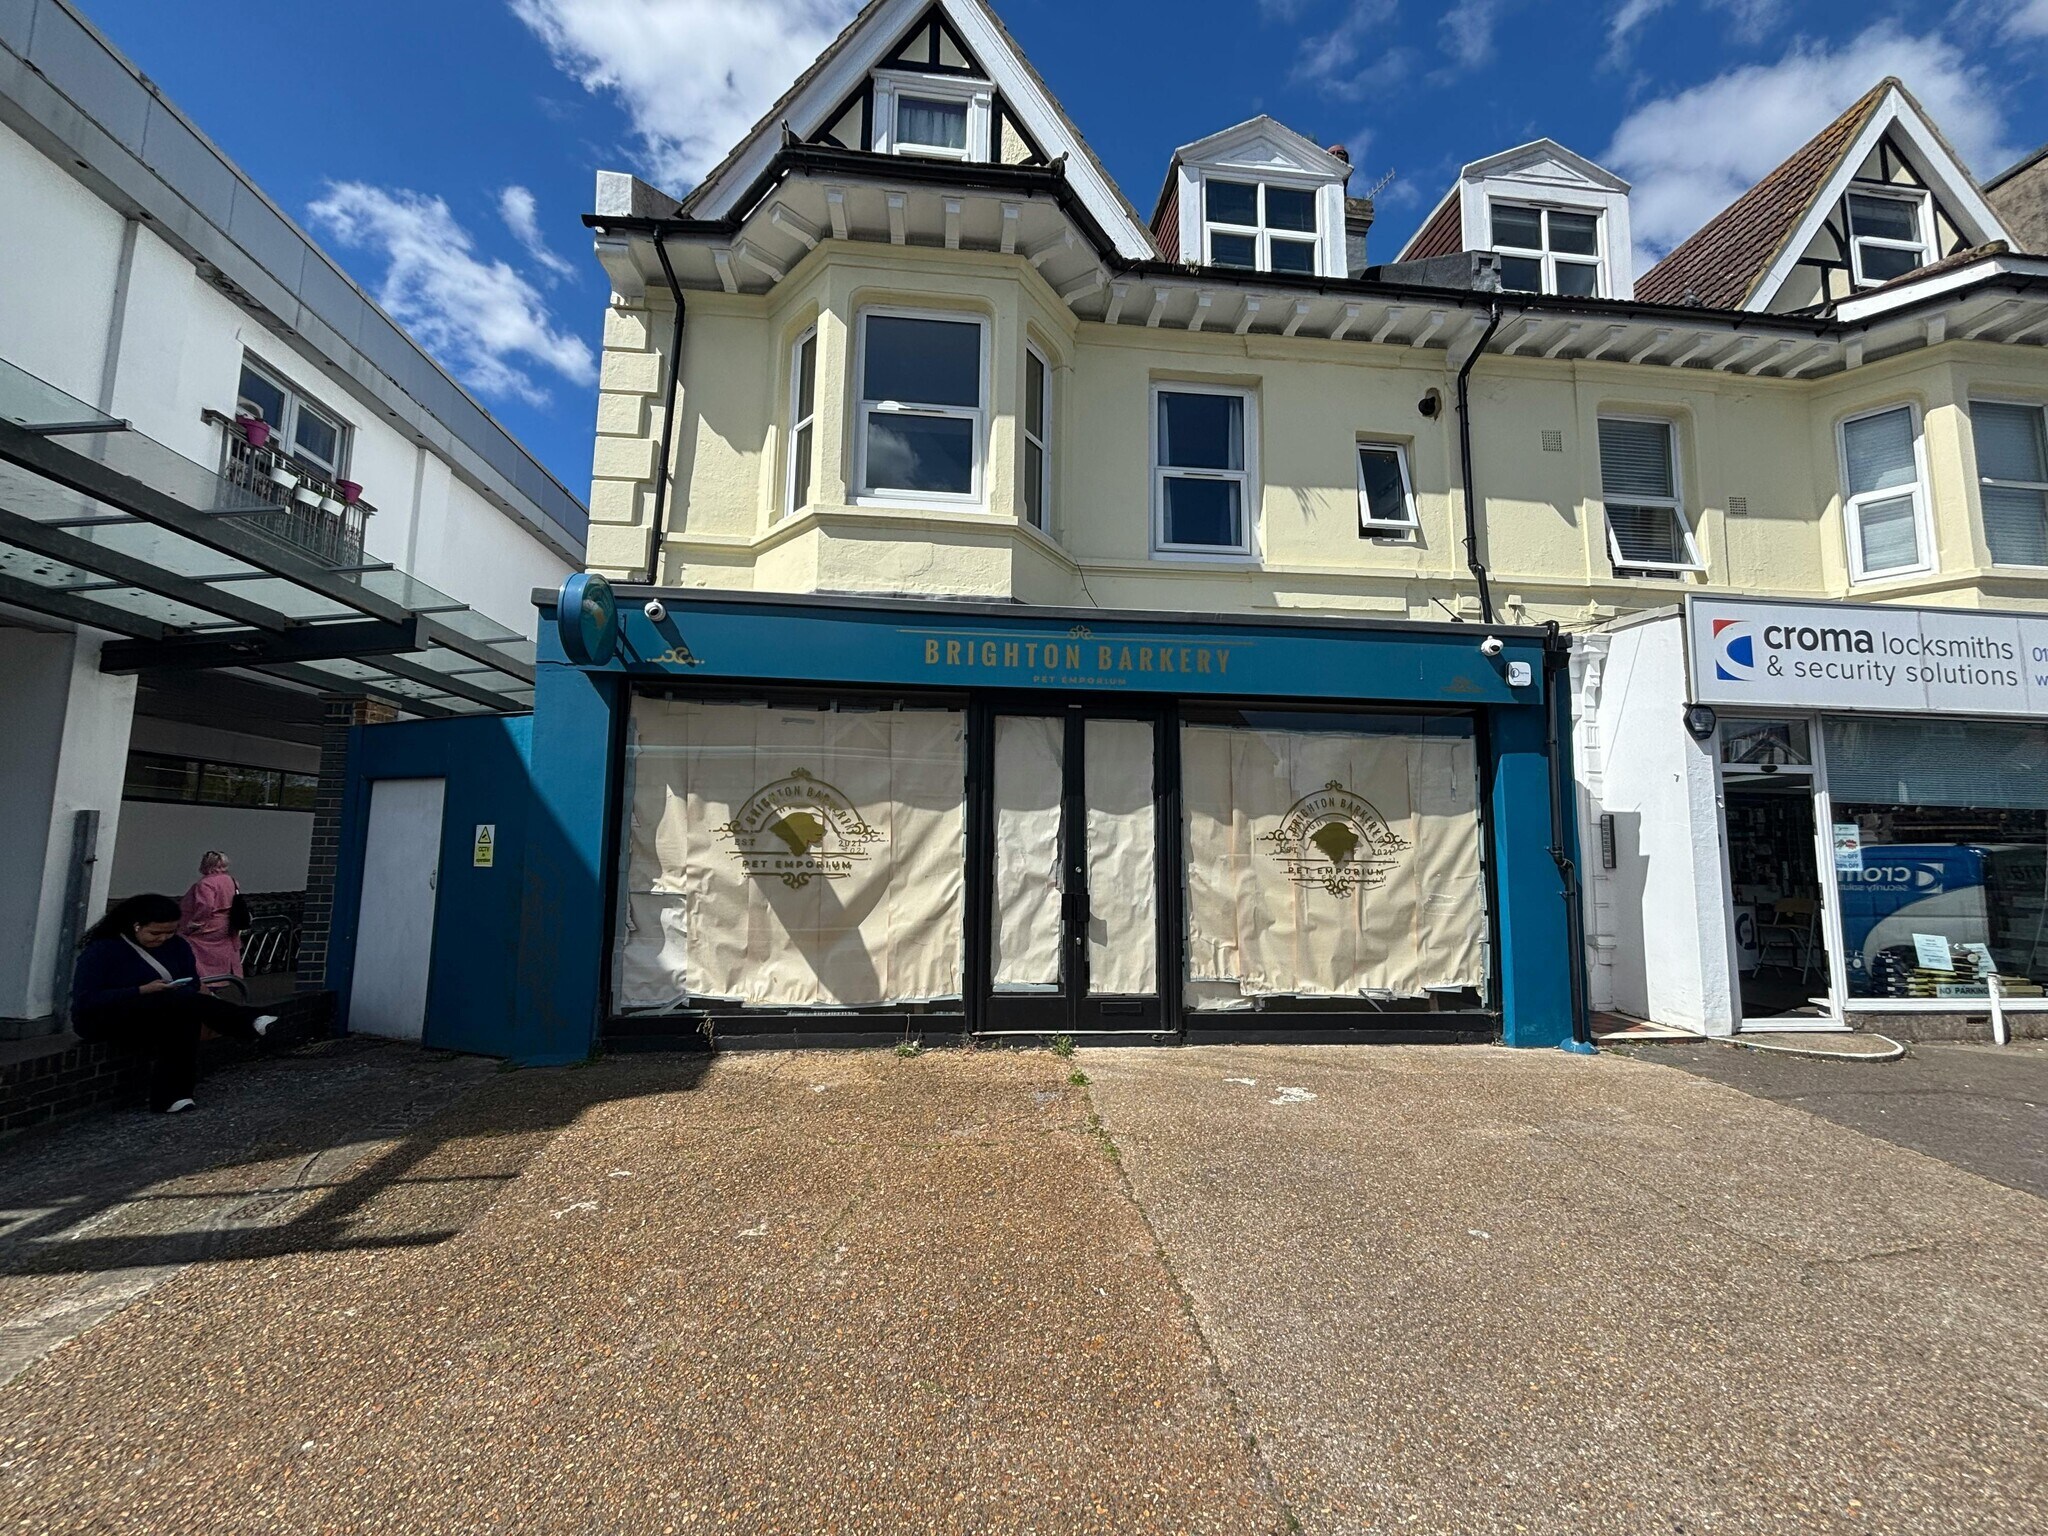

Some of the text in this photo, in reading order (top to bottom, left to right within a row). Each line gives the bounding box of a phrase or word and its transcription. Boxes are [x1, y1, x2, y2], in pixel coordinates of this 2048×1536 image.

[1763, 625, 2014, 660] croma locksmiths
[924, 639, 1230, 674] BRIGHTON BARKERY
[2032, 647, 2048, 662] 01
[1766, 655, 2018, 687] & security solutions
[1033, 675, 1126, 685] PET EMPORIUM
[1288, 797, 1335, 834] BRIGHTON
[734, 838, 755, 846] EST
[742, 860, 852, 869] PET EMPORIUM
[1288, 867, 1384, 876] PET EMPORIUM
[1940, 987, 1951, 995] NO
